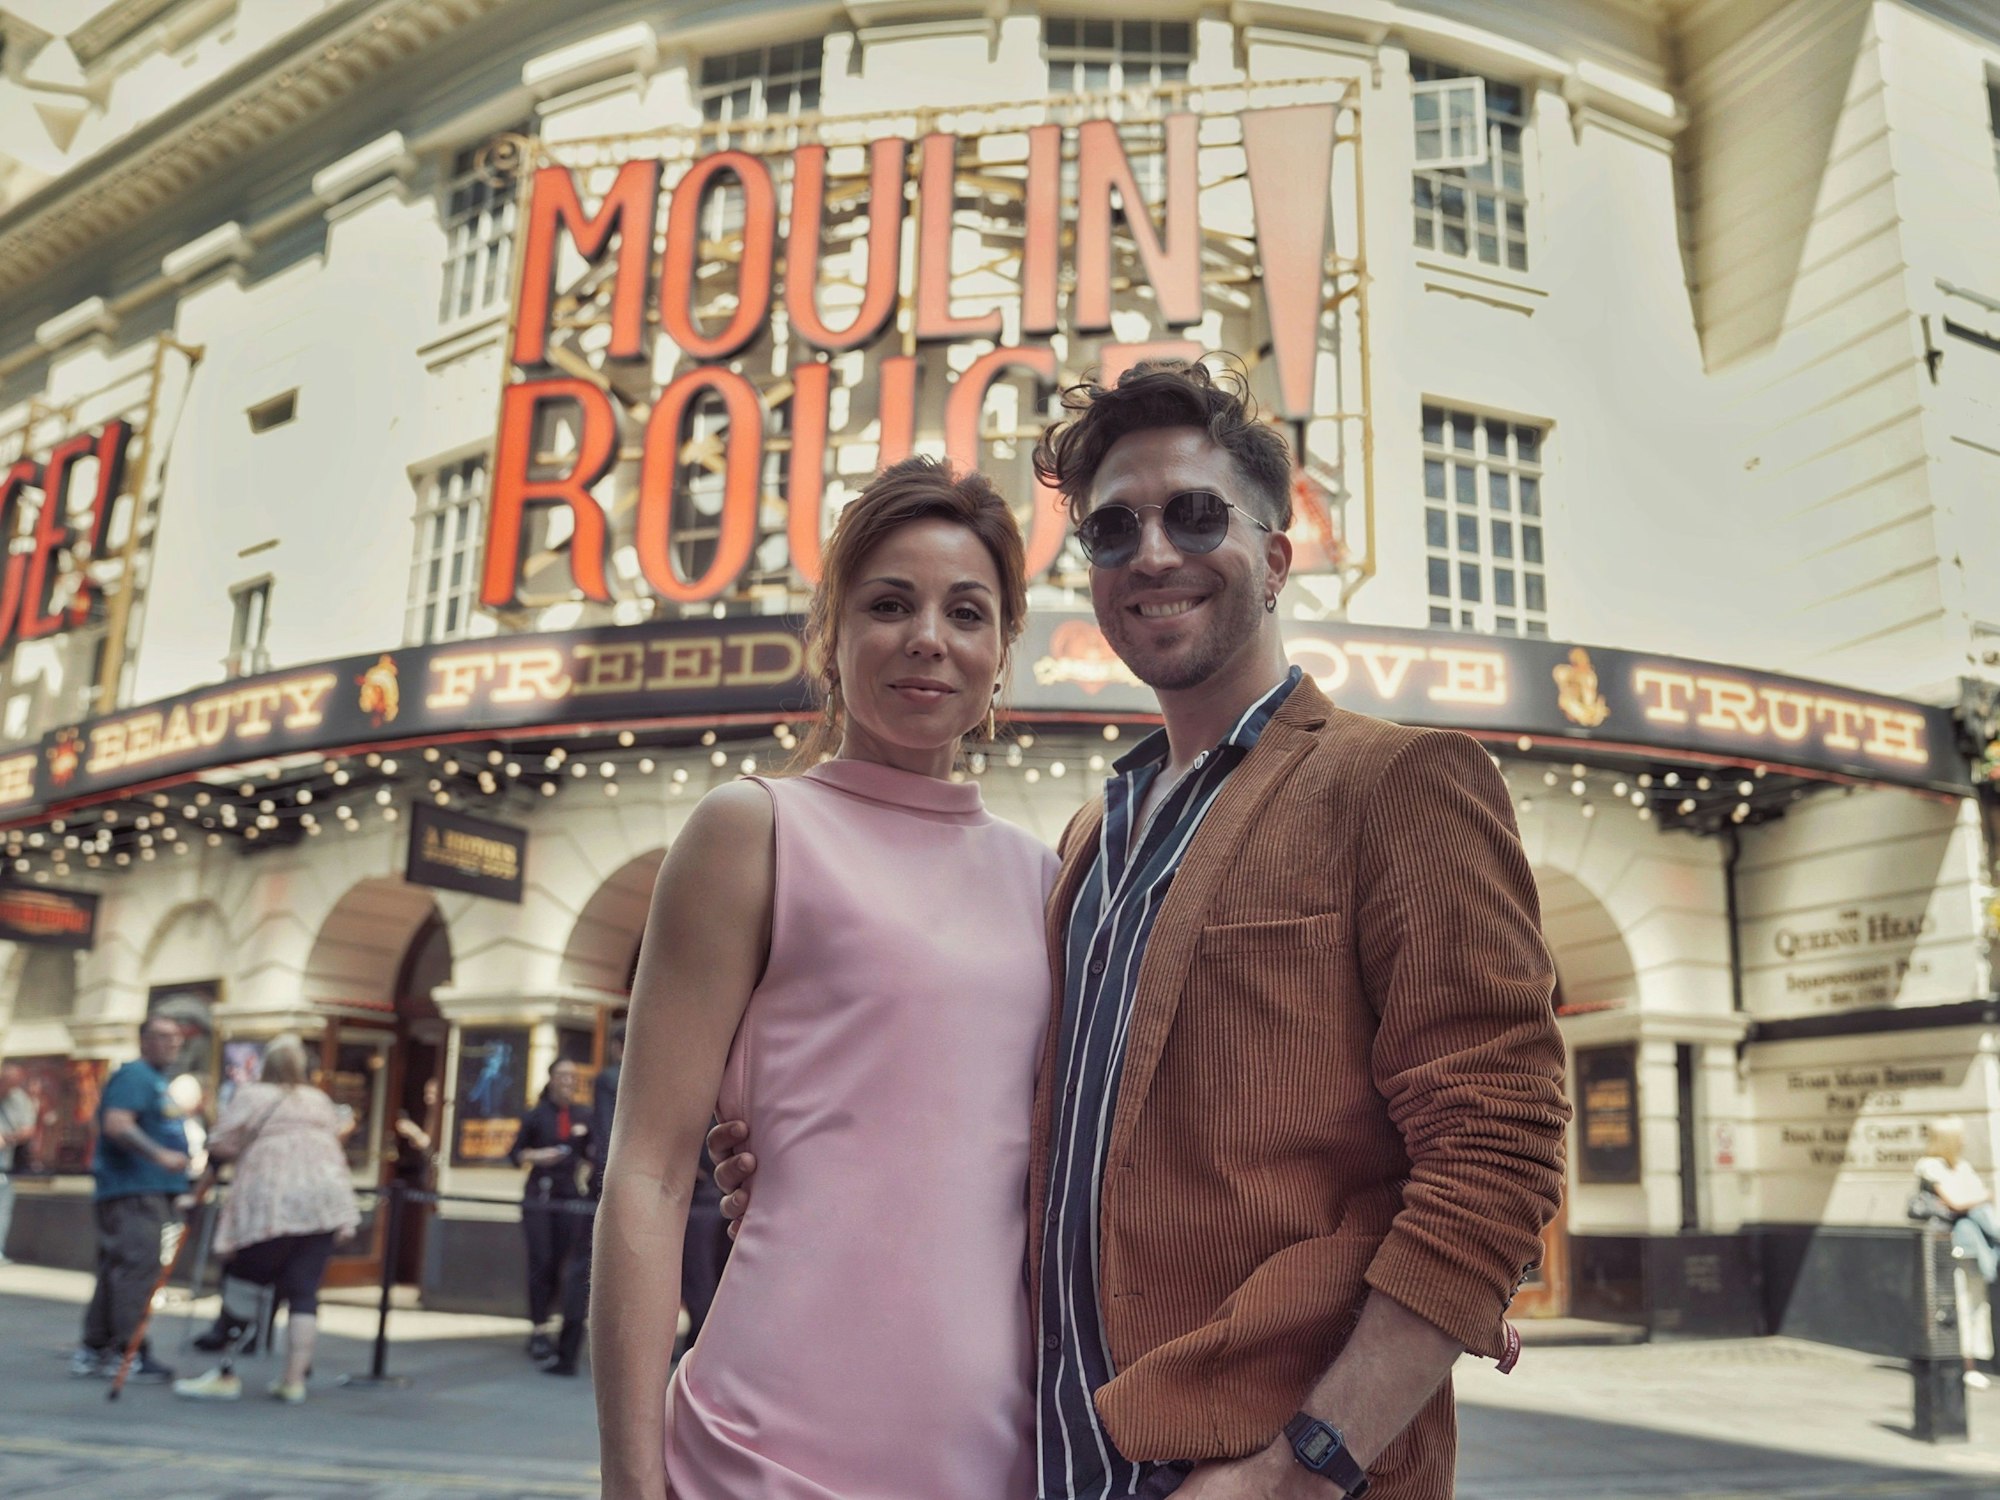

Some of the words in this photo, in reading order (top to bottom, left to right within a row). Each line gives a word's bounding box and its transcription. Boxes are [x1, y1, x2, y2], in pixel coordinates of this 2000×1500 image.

[511, 112, 1201, 366] MOULIN
[480, 340, 1203, 605] ROUG
[426, 632, 836, 708] FREED
[1286, 638, 1507, 705] OVE
[1635, 668, 1929, 764] TRUTH
[85, 673, 338, 774] BEAUTY
